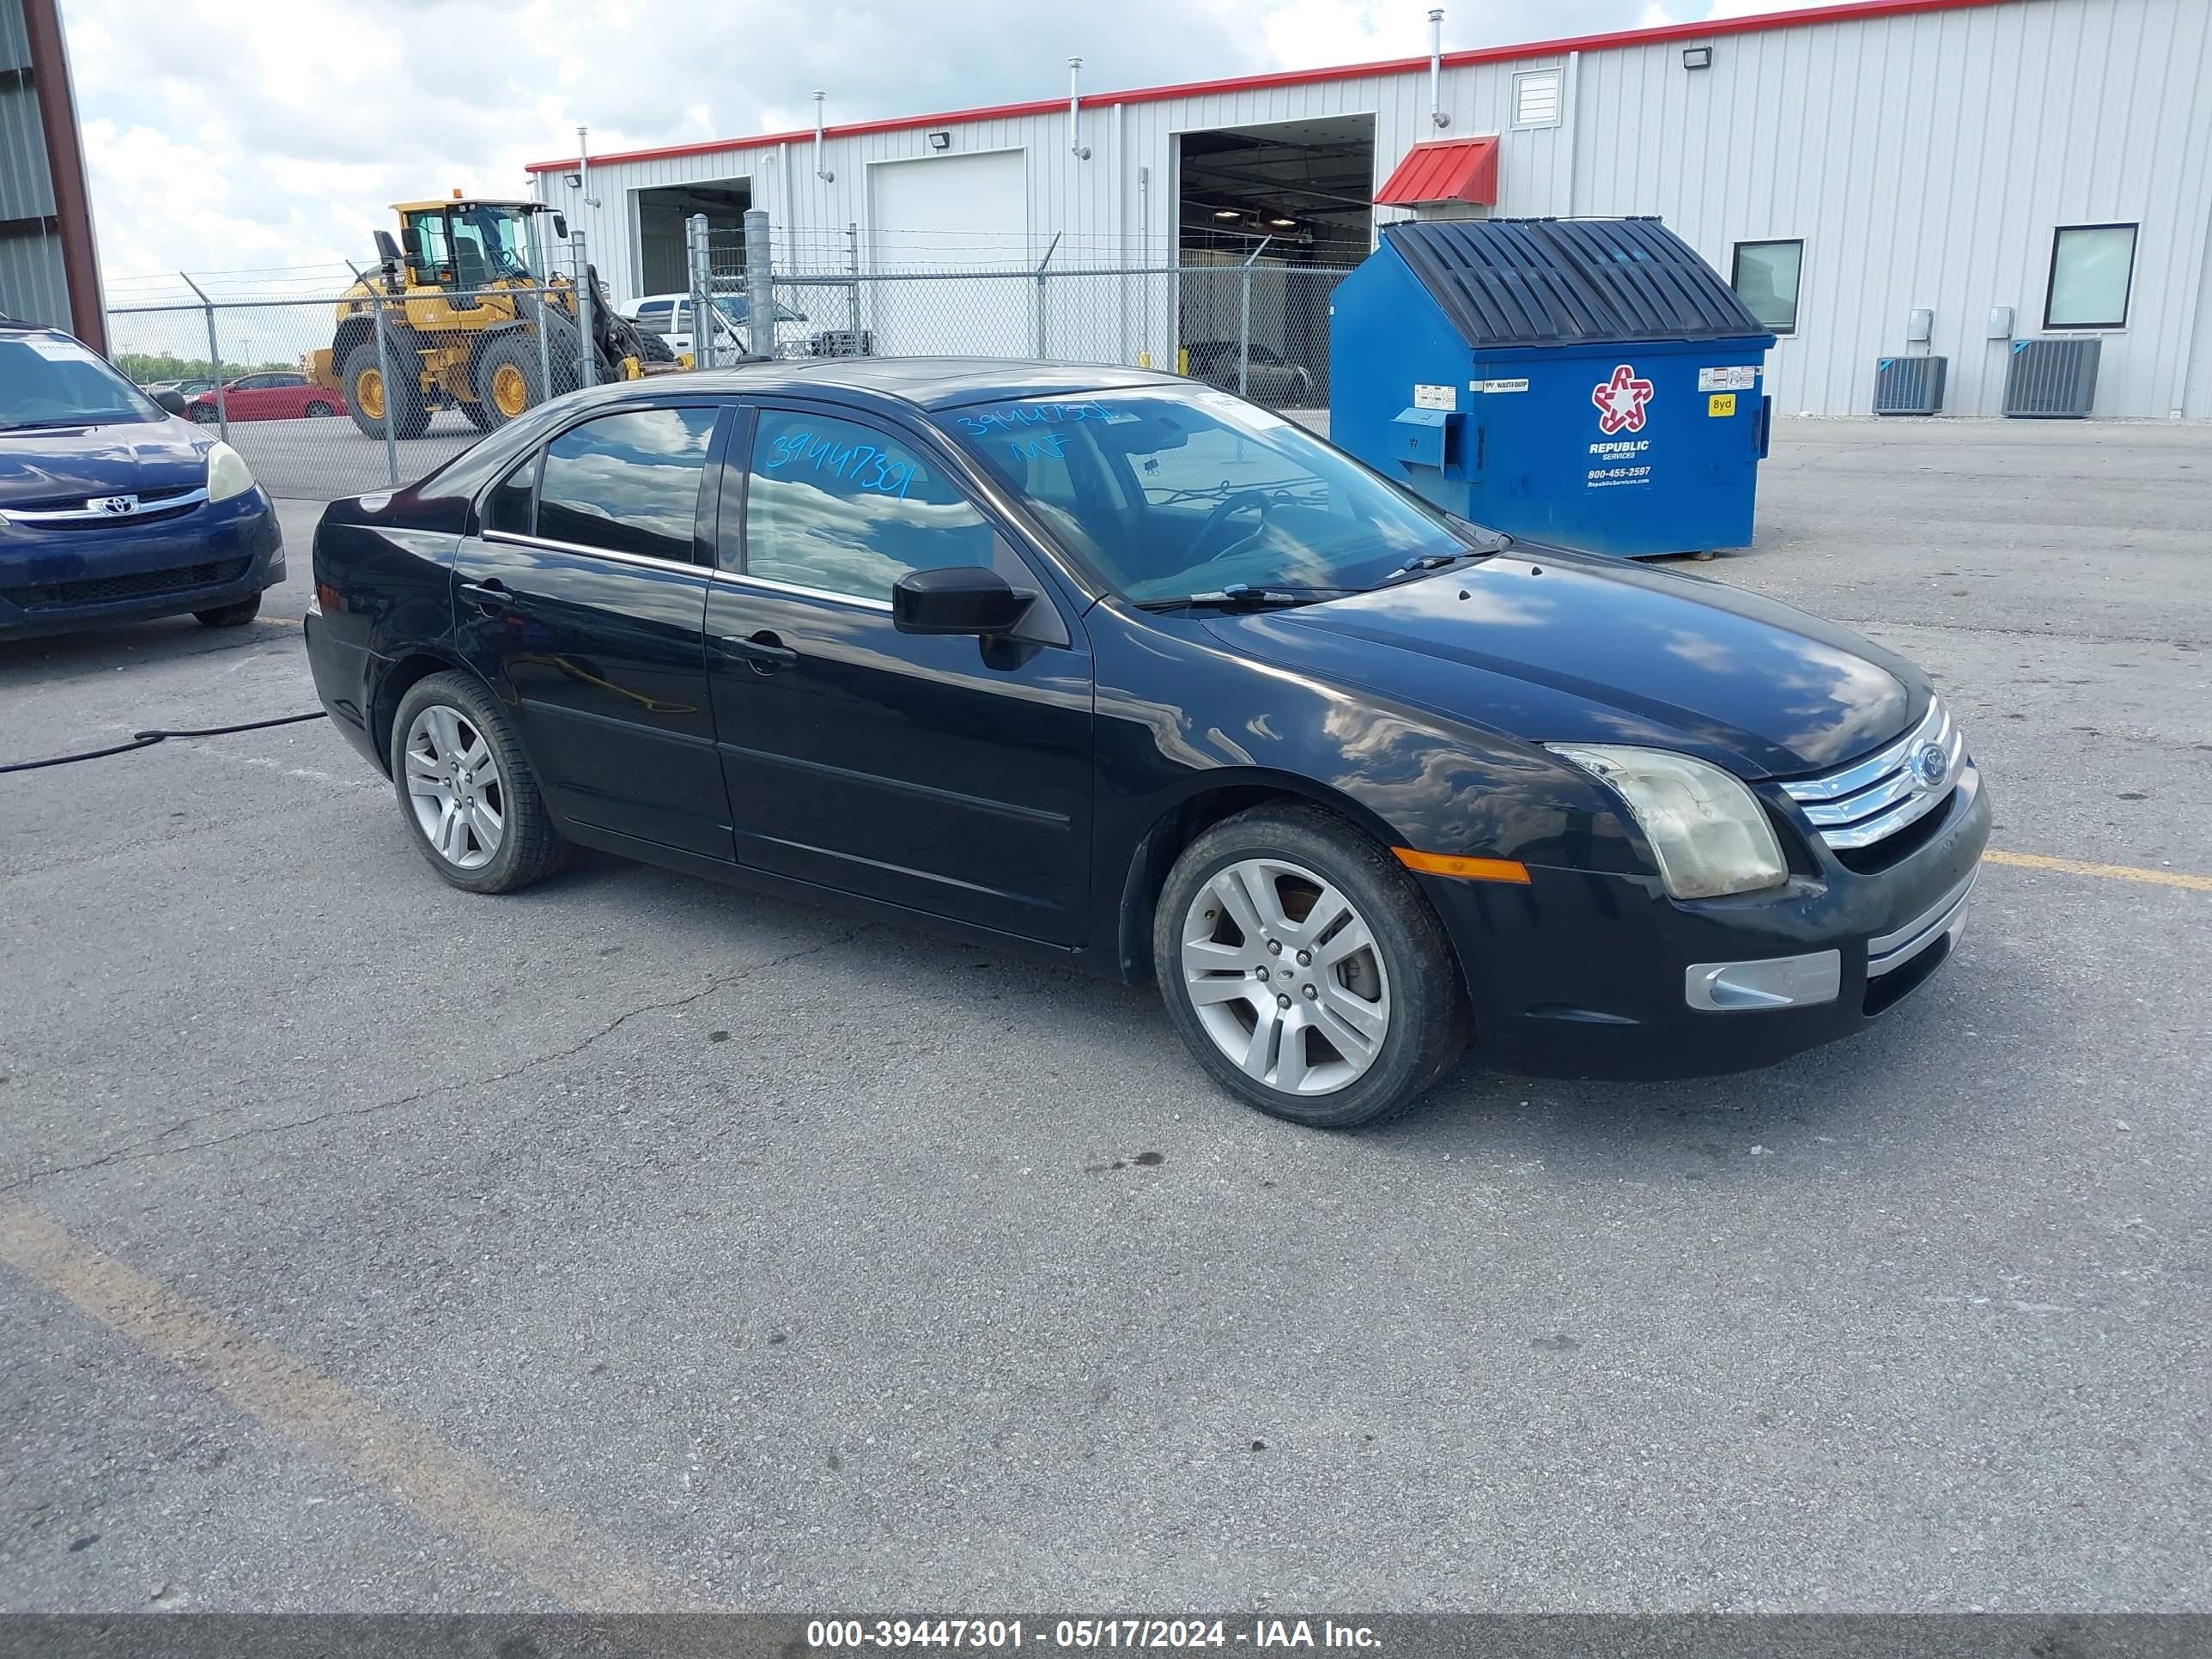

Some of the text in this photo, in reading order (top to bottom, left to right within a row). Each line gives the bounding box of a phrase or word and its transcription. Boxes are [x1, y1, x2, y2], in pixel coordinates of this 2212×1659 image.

[1713, 398, 1732, 410] 8yd
[957, 401, 1114, 435] 39447301
[1589, 441, 1650, 453] REPUBLIC
[1602, 452, 1636, 460] SERVICES
[766, 432, 916, 501] 39447301
[1588, 466, 1651, 479] 800-455-2597
[1587, 479, 1650, 488] RepublicServices.com
